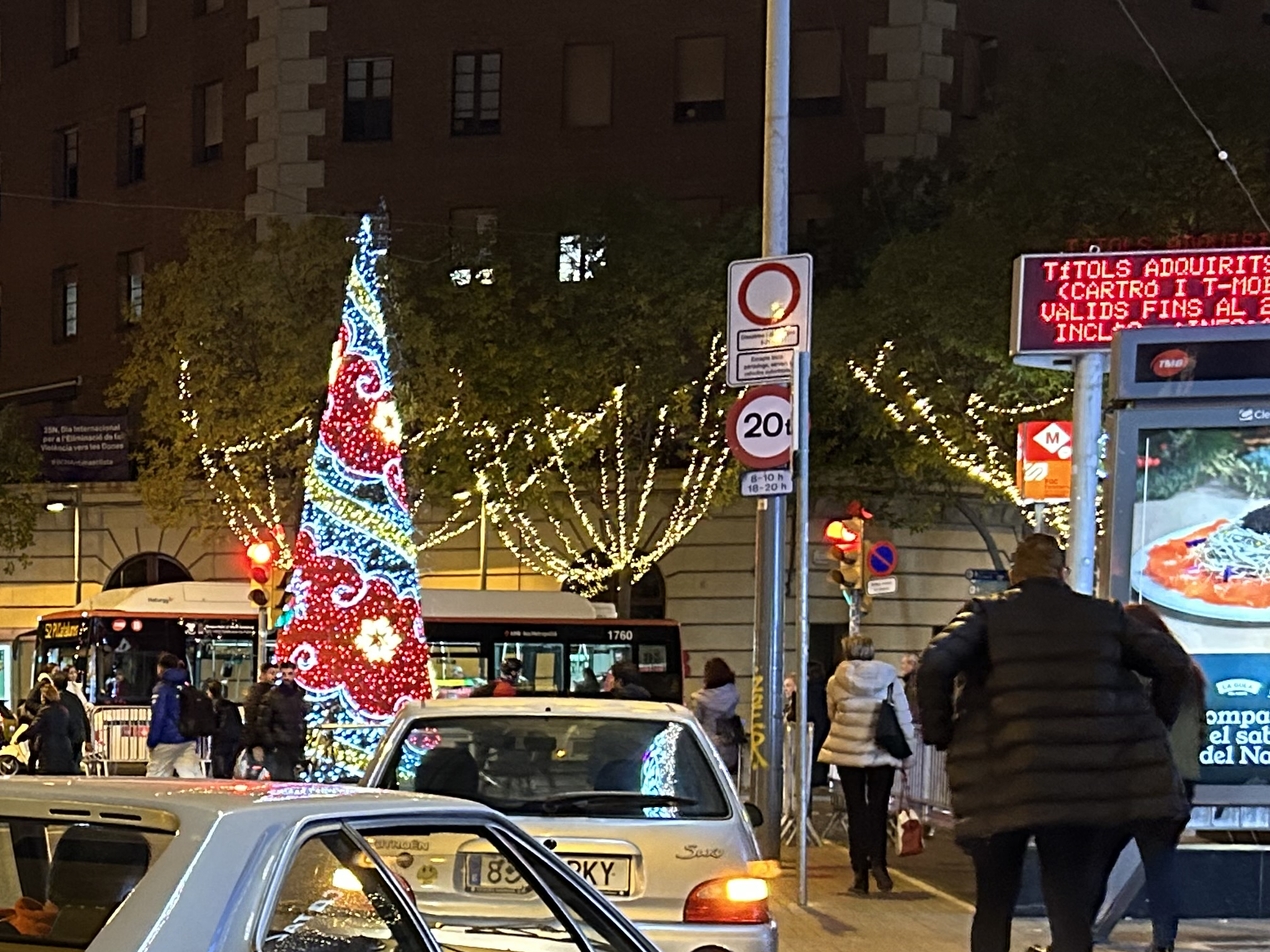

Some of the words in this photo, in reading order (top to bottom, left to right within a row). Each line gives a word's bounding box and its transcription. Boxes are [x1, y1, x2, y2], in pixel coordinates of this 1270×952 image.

[1175, 278, 1187, 297] I
[1143, 298, 1203, 319] FINS
[1216, 297, 1247, 316] AL
[1045, 433, 1059, 444] M
[751, 473, 775, 483] 8-10
[748, 483, 778, 493] 18-20
[608, 630, 633, 640] 1760
[1209, 725, 1230, 745] el
[1199, 745, 1234, 765] del
